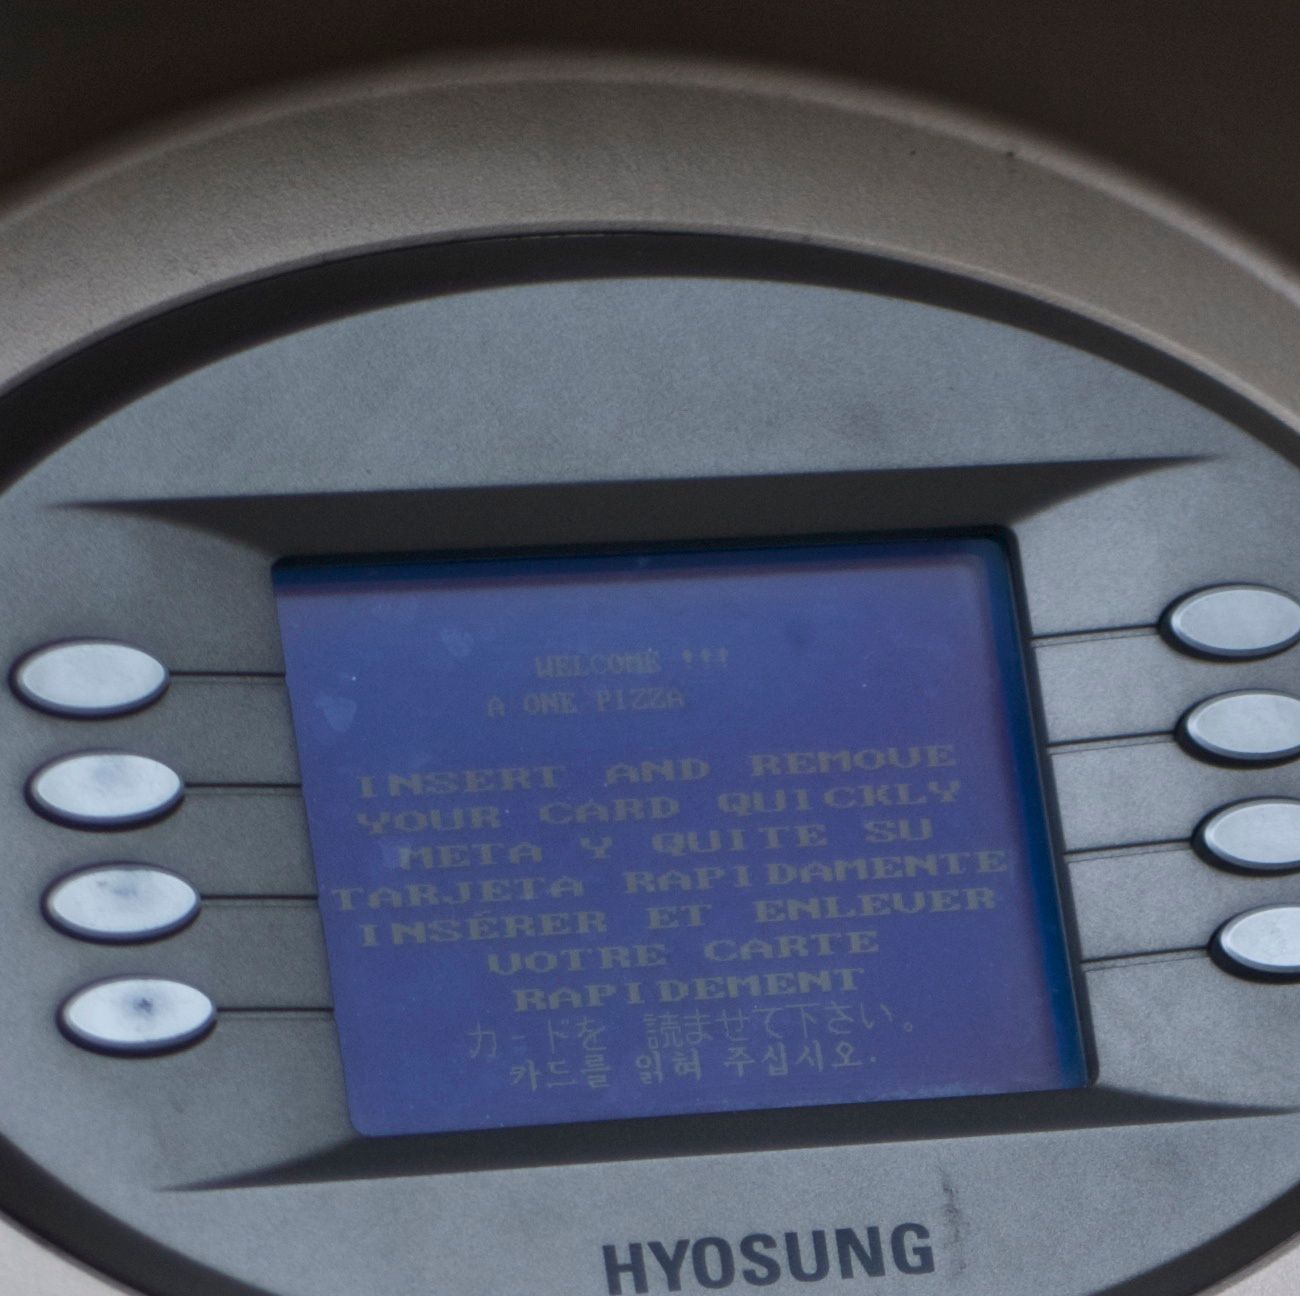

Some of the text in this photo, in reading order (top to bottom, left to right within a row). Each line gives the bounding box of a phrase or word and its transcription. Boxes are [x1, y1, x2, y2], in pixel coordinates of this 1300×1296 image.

[535, 653, 661, 678] WELCOME
[596, 687, 686, 712] PIZZA
[357, 744, 957, 798] INSERT AND REMOVE
[357, 780, 961, 834] YOUR CARD QUICKLY
[400, 818, 933, 870] META Y QUITE SU
[331, 851, 1008, 911] TARJETA RAPIDAMENTE
[646, 903, 713, 930] ET
[751, 887, 996, 923] ENLEVER
[486, 930, 880, 975] VOTRE CARTE
[511, 967, 866, 1012] RAPIDEMENT
[510, 1054, 612, 1091] 카드를
[602, 1222, 936, 1296] HYOSUNG
